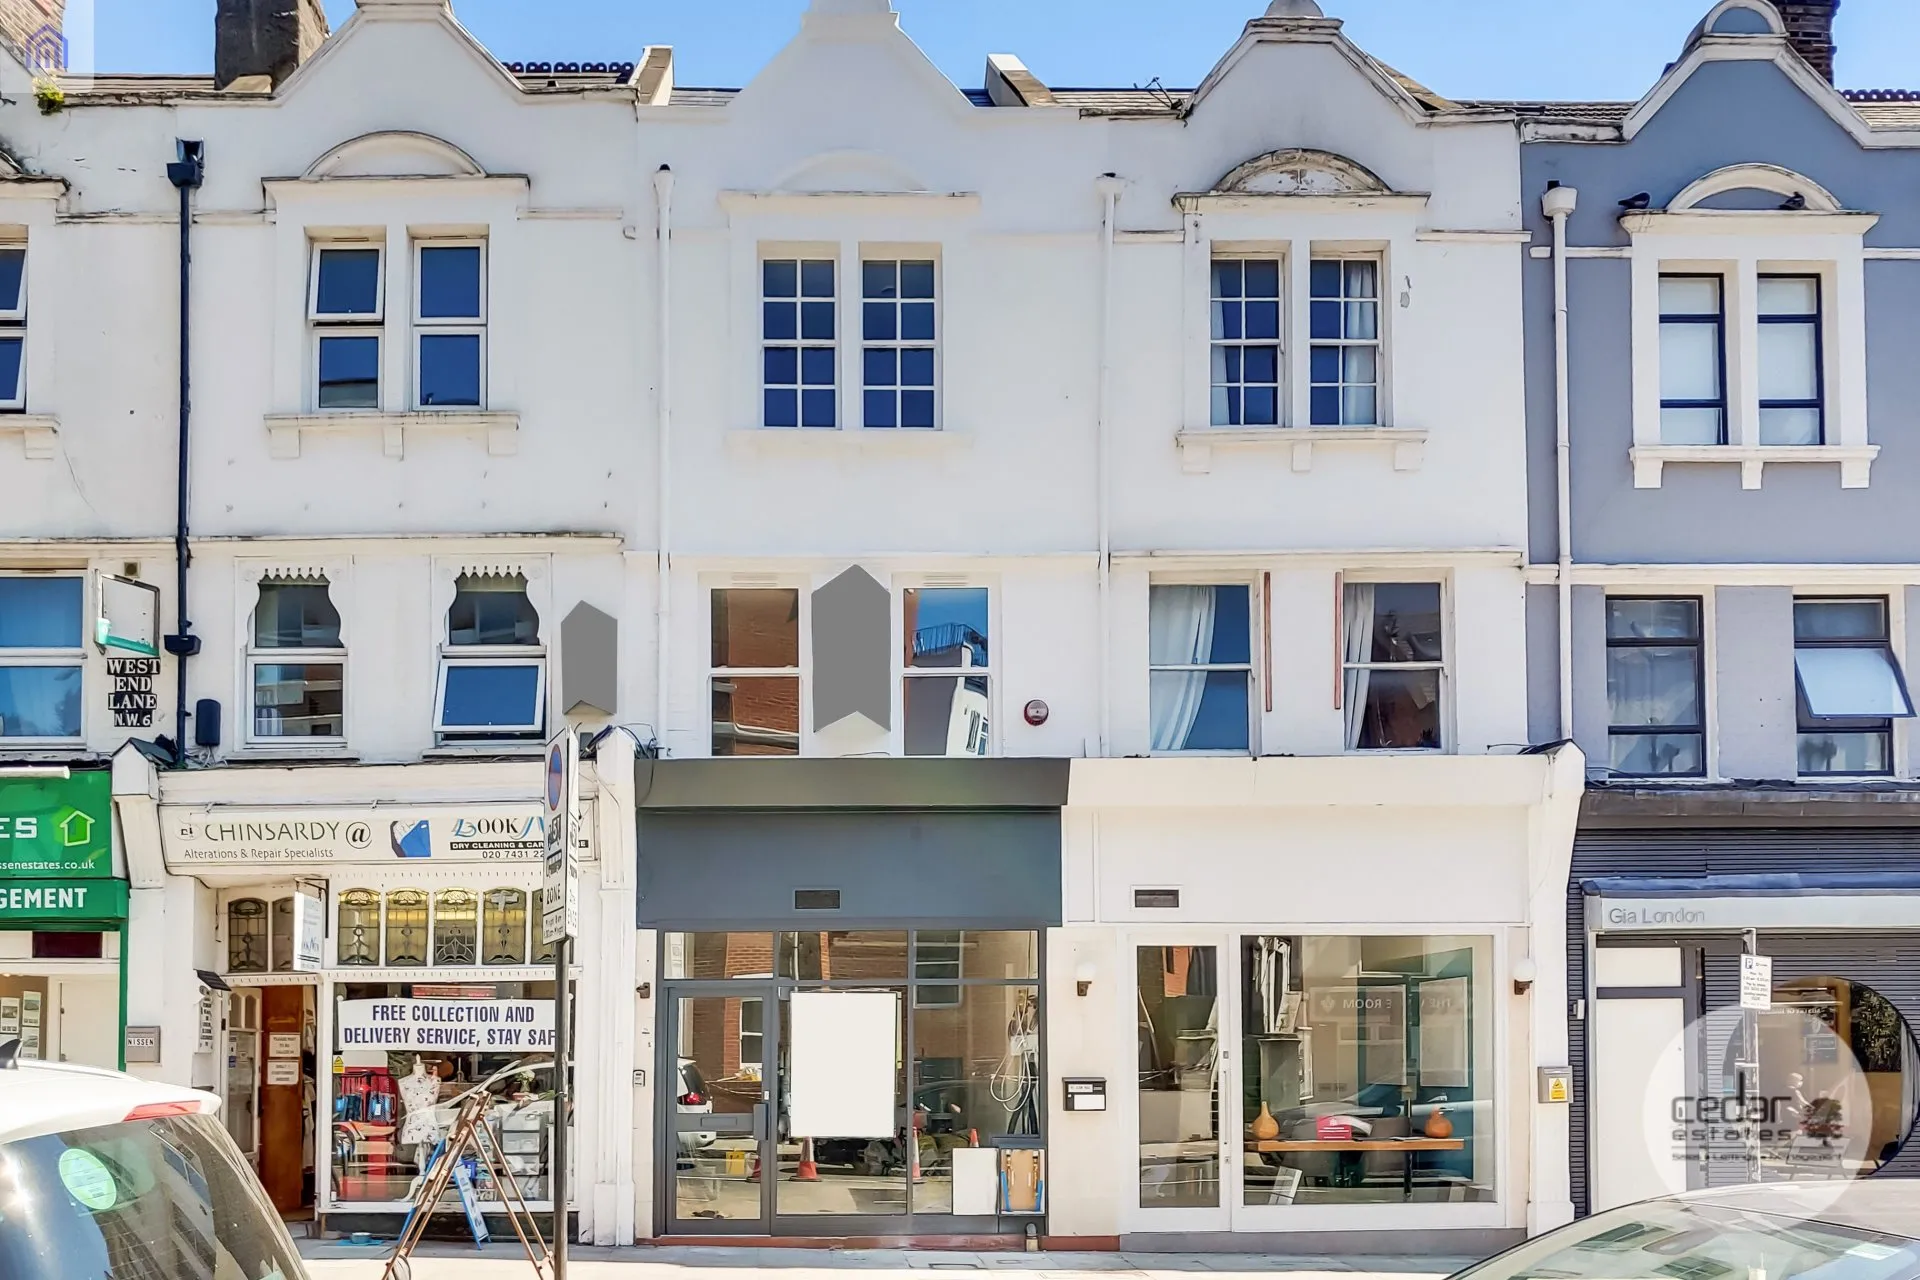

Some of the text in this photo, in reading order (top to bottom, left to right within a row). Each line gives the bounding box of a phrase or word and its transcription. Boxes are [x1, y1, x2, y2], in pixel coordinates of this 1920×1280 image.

[107, 659, 161, 674] WEST
[115, 676, 152, 692] END
[108, 694, 157, 709] LANE
[142, 714, 151, 726] 6
[204, 822, 339, 841] CHINSARDY
[345, 821, 372, 849] @
[475, 841, 516, 849] CLEANING
[184, 847, 334, 860] Alterations & Repair Specialists
[482, 851, 500, 859] 020
[505, 850, 529, 858] 7431
[546, 882, 561, 905] ZONE
[1609, 907, 1706, 924] Gia London
[372, 1005, 535, 1023] FREE COLLECTION AND
[344, 1027, 556, 1047] DELIVERY SERVICE, STAY SAF
